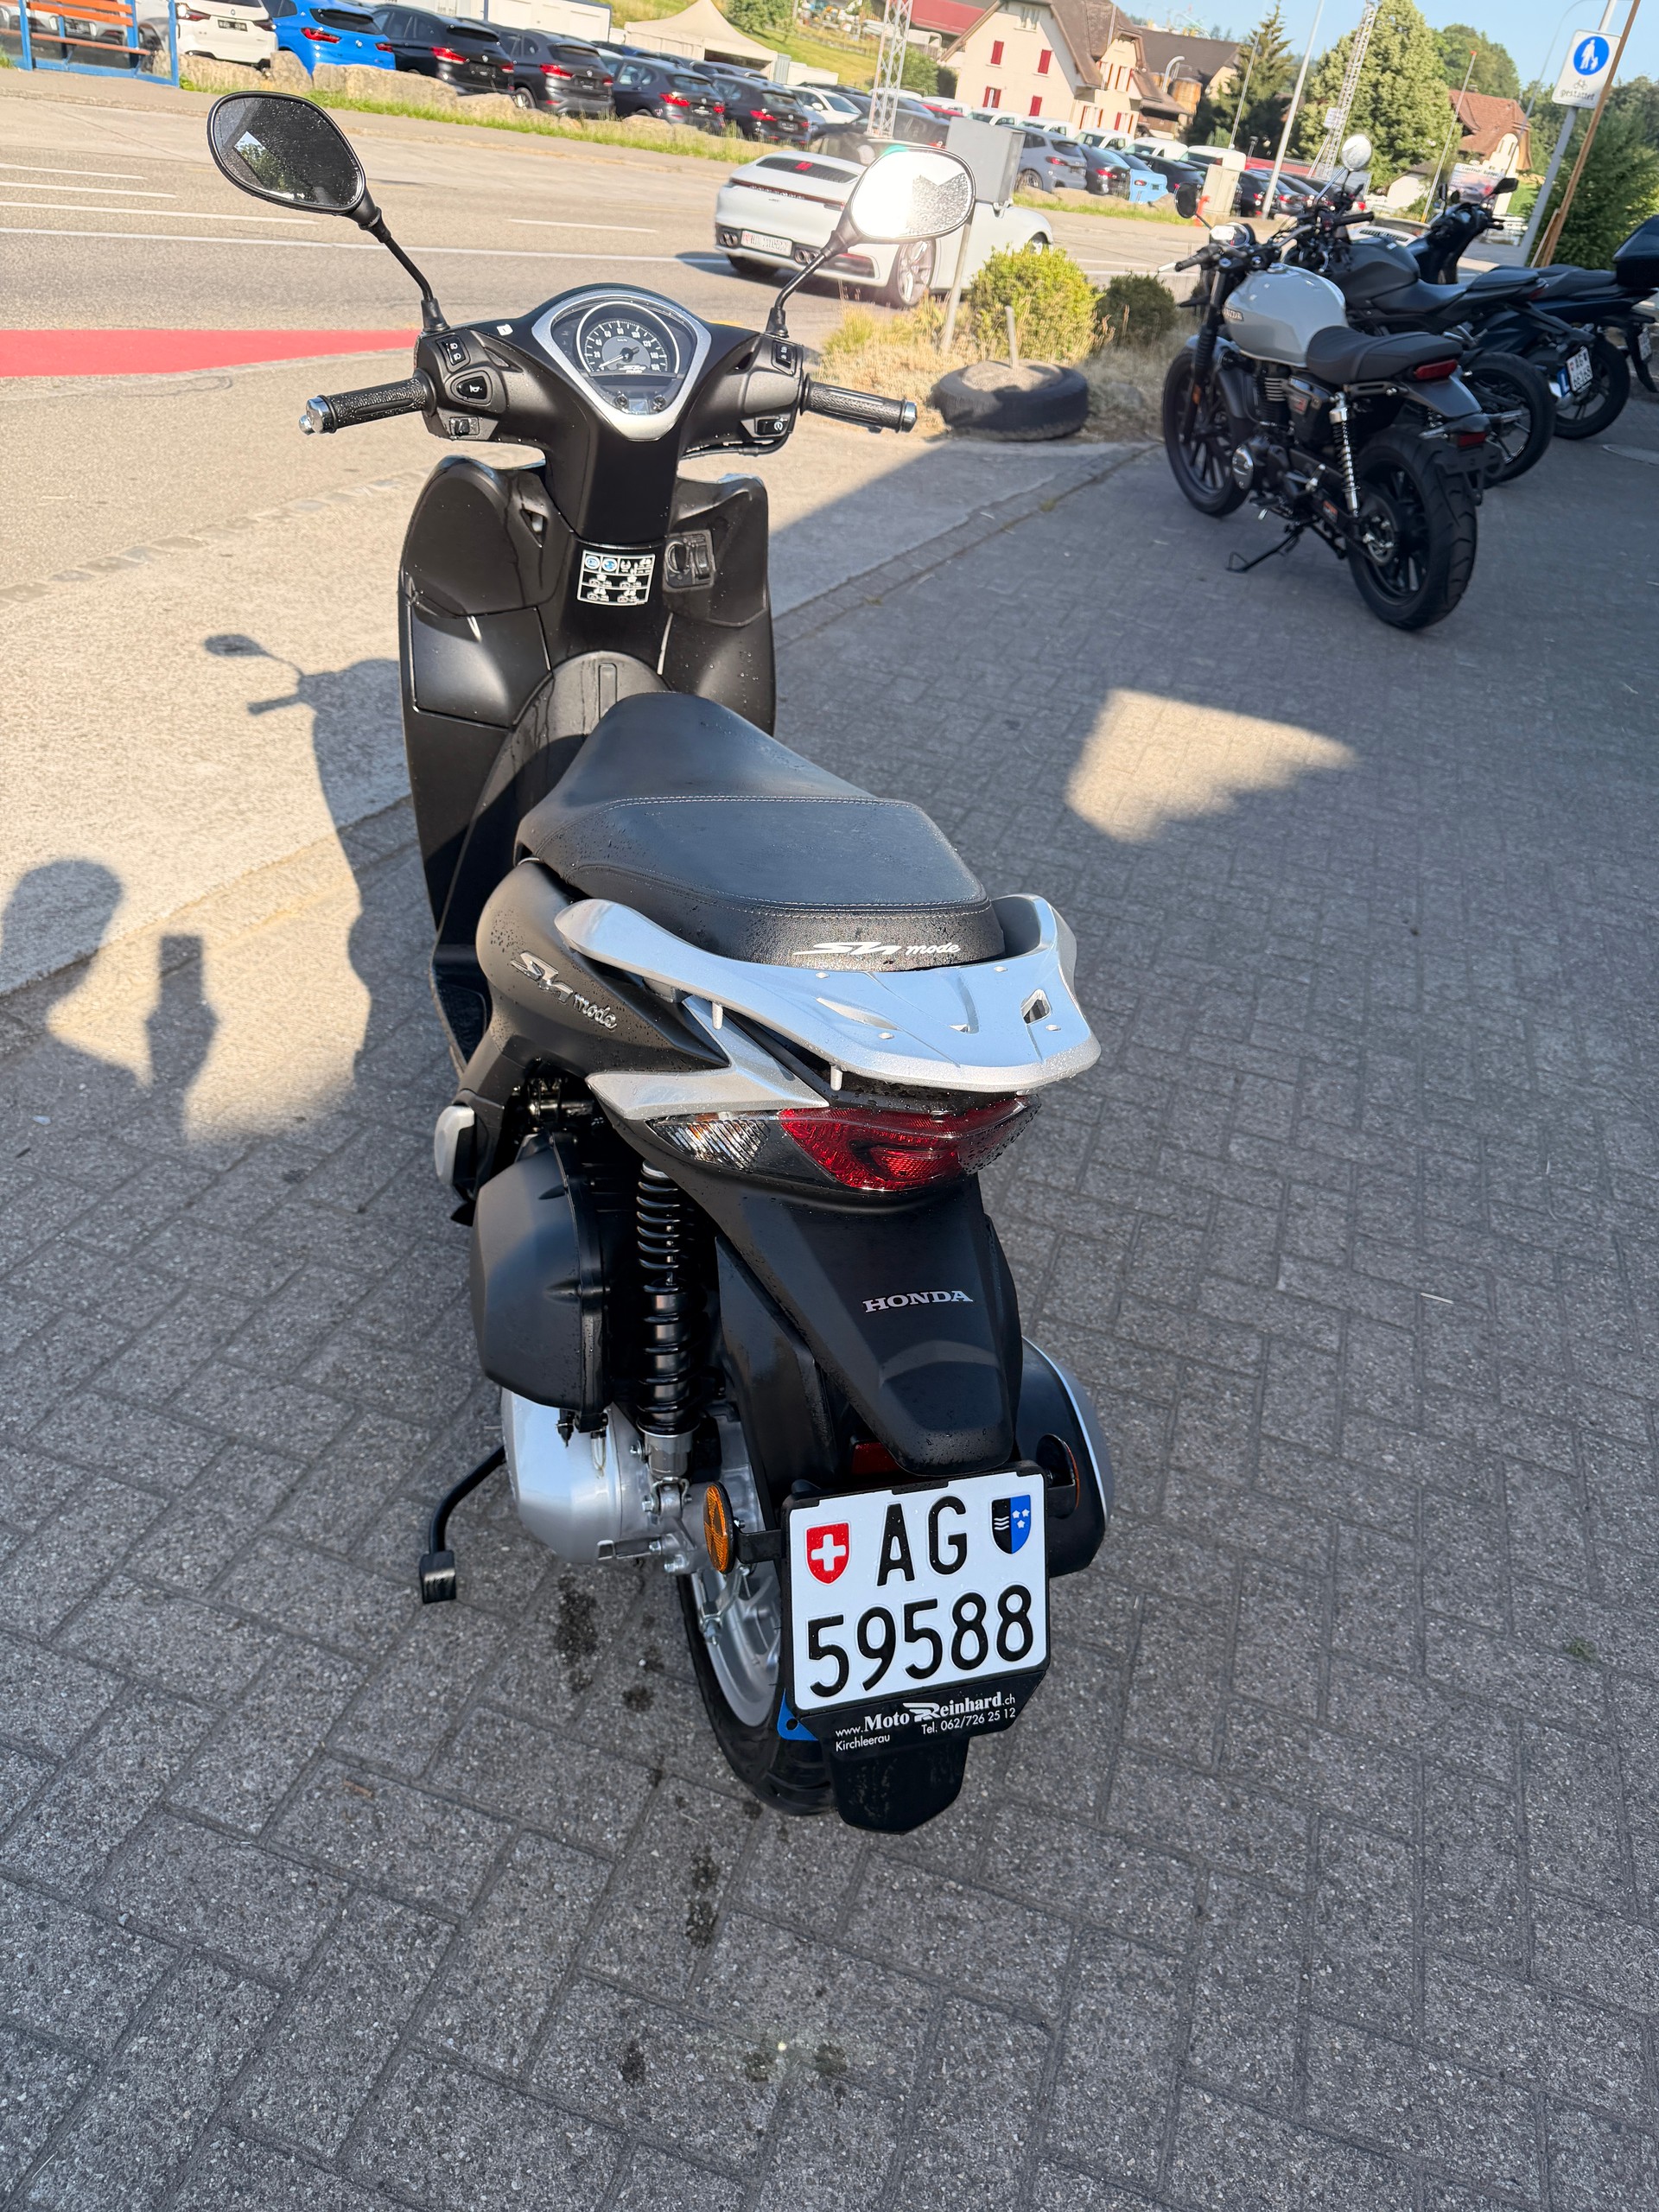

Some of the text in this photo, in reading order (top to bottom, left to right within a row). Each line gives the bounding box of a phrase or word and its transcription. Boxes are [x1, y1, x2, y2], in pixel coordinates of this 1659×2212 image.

[905, 942, 961, 955] mode
[573, 993, 618, 1030] mode
[862, 1290, 974, 1313] HONDA
[876, 1495, 969, 1587] AG
[807, 1584, 1034, 1698] 59588
[835, 1707, 1016, 1751] Kirchleerau Tel. 062/726 25 12
